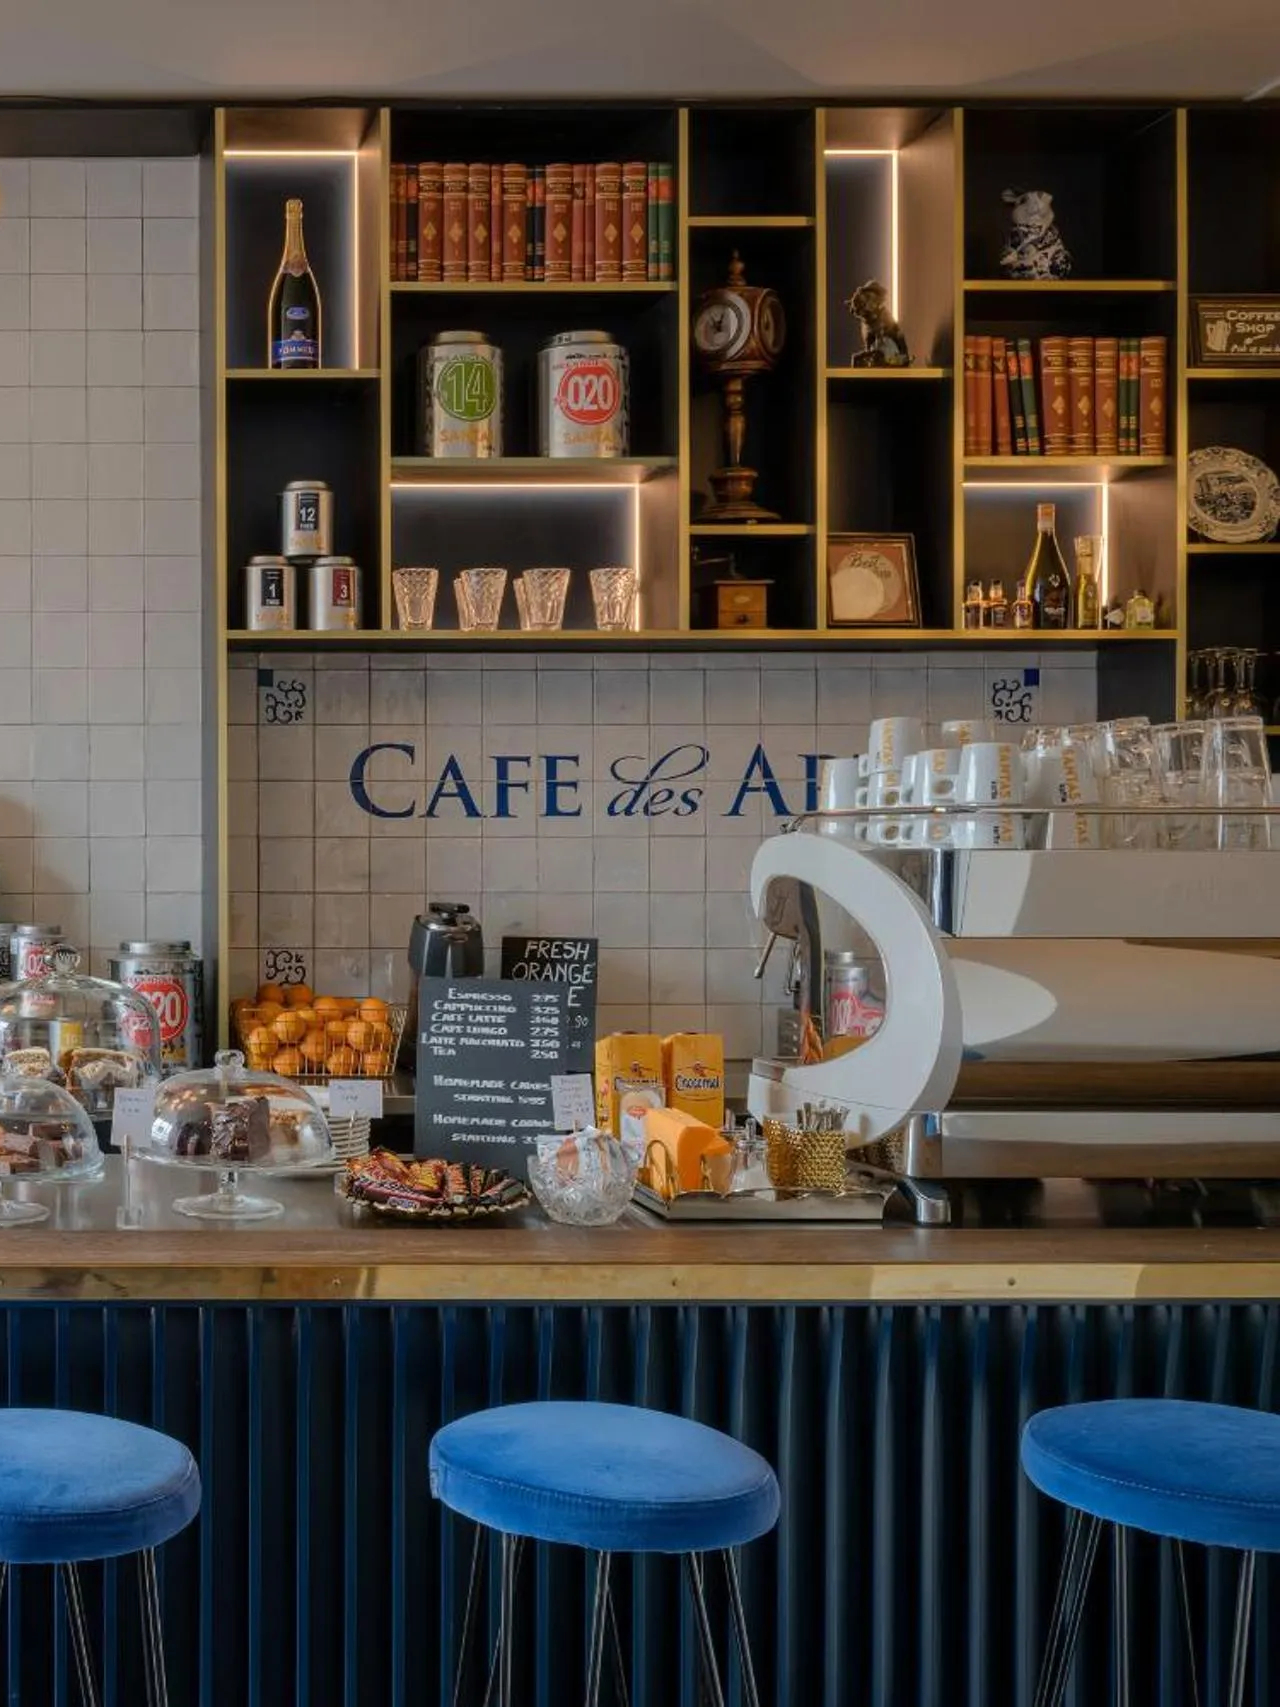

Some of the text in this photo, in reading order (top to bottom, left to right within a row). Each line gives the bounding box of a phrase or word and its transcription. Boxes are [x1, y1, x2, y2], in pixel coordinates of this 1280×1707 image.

[1235, 322, 1276, 333] SHOP
[447, 363, 487, 412] 14
[567, 374, 616, 411] 020
[299, 507, 315, 522] 12
[269, 583, 276, 598] 1
[340, 585, 348, 599] 3
[348, 743, 582, 819] CAFE
[607, 744, 710, 817] des
[524, 940, 590, 960] FRESH
[511, 962, 596, 984] ORANGE
[430, 1046, 457, 1056] TEA
